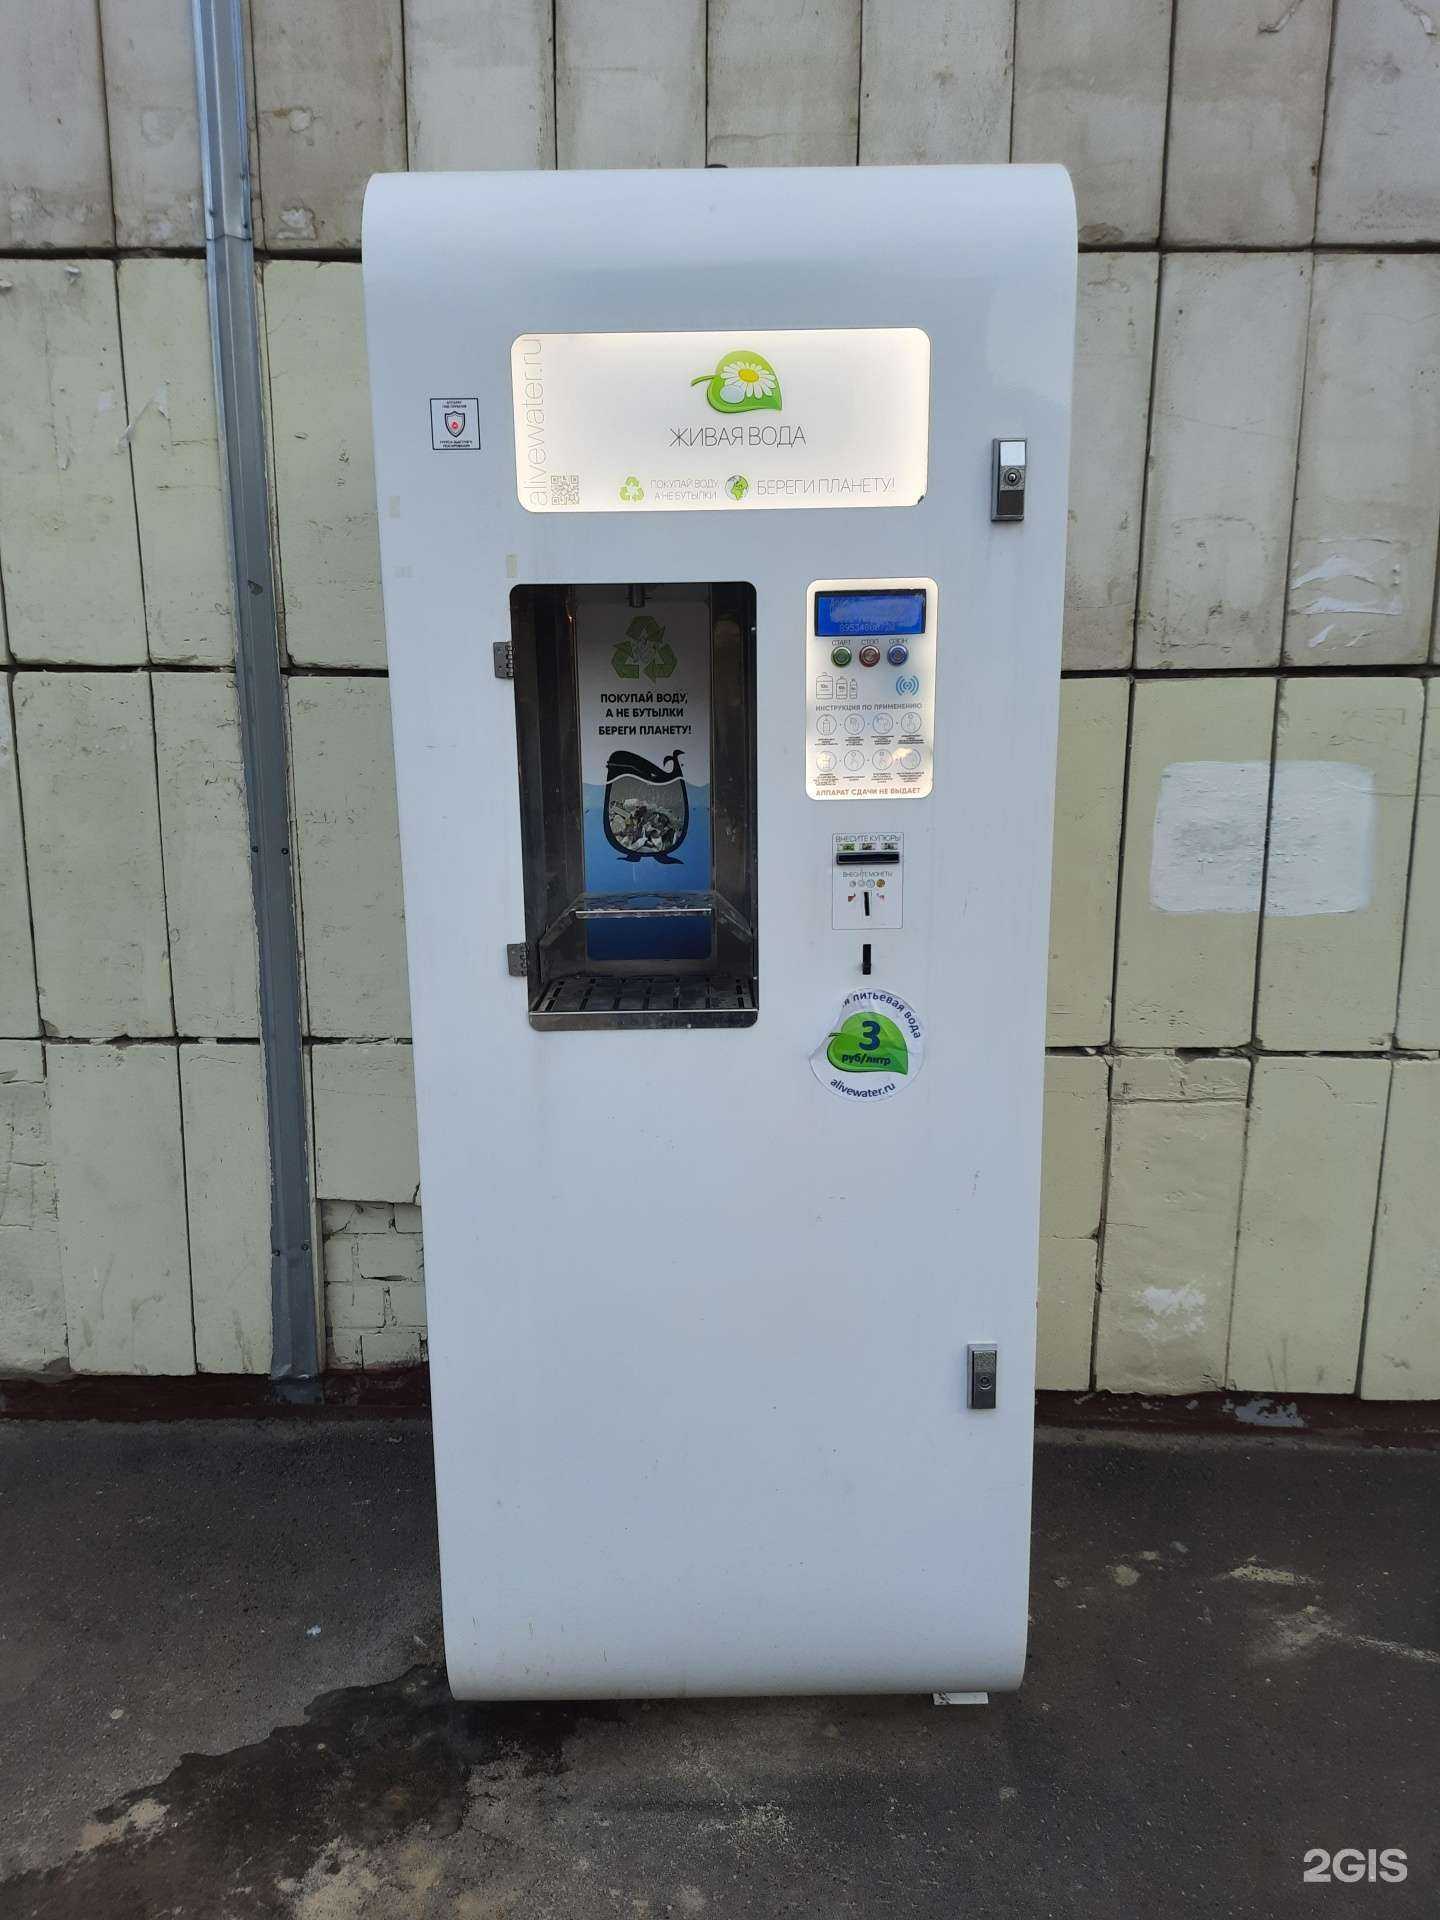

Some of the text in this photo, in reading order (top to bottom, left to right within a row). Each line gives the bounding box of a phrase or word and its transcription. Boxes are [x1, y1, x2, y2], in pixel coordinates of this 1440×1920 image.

[521, 338, 548, 506] alivewater.ru
[669, 425, 807, 448] ЖИВАЯ ВОДА
[650, 478, 693, 489] ПОКУПАЙ
[757, 476, 895, 496] БЕРЕГИ ПЛАНЕТУ!
[654, 490, 661, 501] А
[662, 490, 675, 501] НЕ
[600, 691, 688, 705] ПОКУПАЙ ВОДУ,
[605, 708, 684, 718] А НЕ БУТЫЛКИ
[815, 704, 861, 712] ИНСТРУКЦИЯ
[598, 725, 692, 736] БЕРЕГИ ПЛАНЕТУ!
[816, 788, 849, 796] АППАРАТ
[851, 788, 878, 796] СДАЧИ
[890, 787, 921, 795] ВЫДАЕТ
[853, 991, 905, 1013] питьевая
[903, 1011, 921, 1039] вода
[858, 1020, 881, 1051] 3
[841, 1053, 892, 1066] руб/литр
[830, 1078, 896, 1098] alivewater.ru
